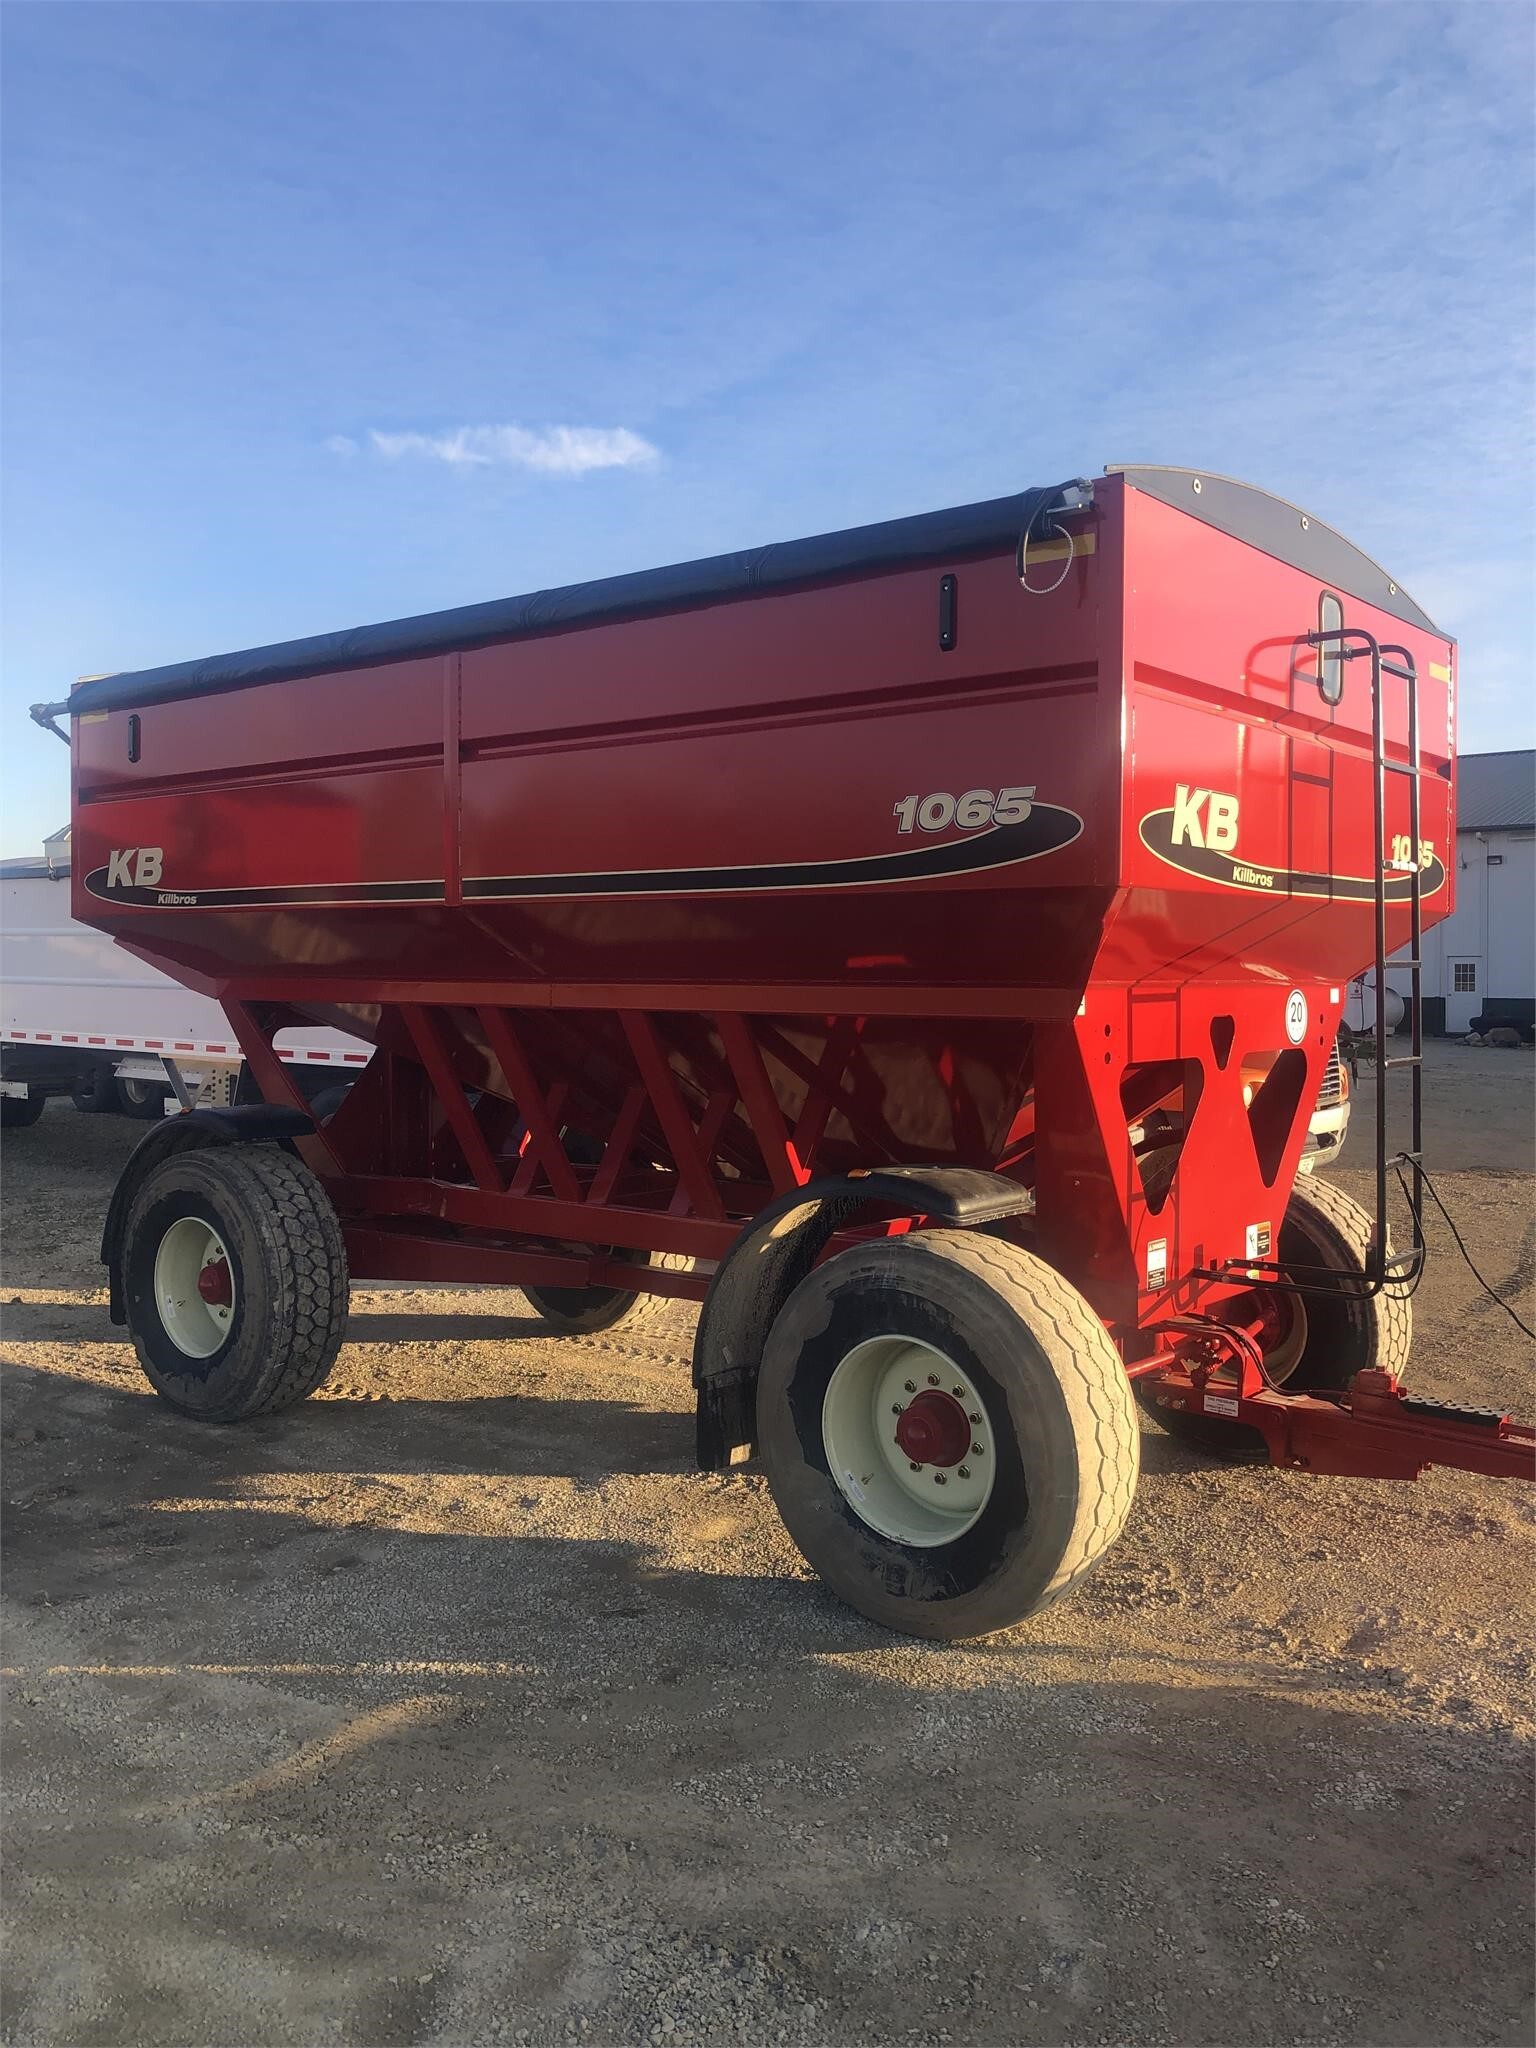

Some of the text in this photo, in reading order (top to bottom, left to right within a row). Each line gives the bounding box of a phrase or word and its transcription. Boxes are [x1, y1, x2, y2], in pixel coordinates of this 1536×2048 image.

[893, 786, 1036, 834] 1065
[1171, 783, 1240, 852] KB
[107, 847, 163, 888] KB
[1232, 865, 1273, 888] Killbros
[157, 893, 197, 905] Killbros
[1290, 1001, 1303, 1023] 20
